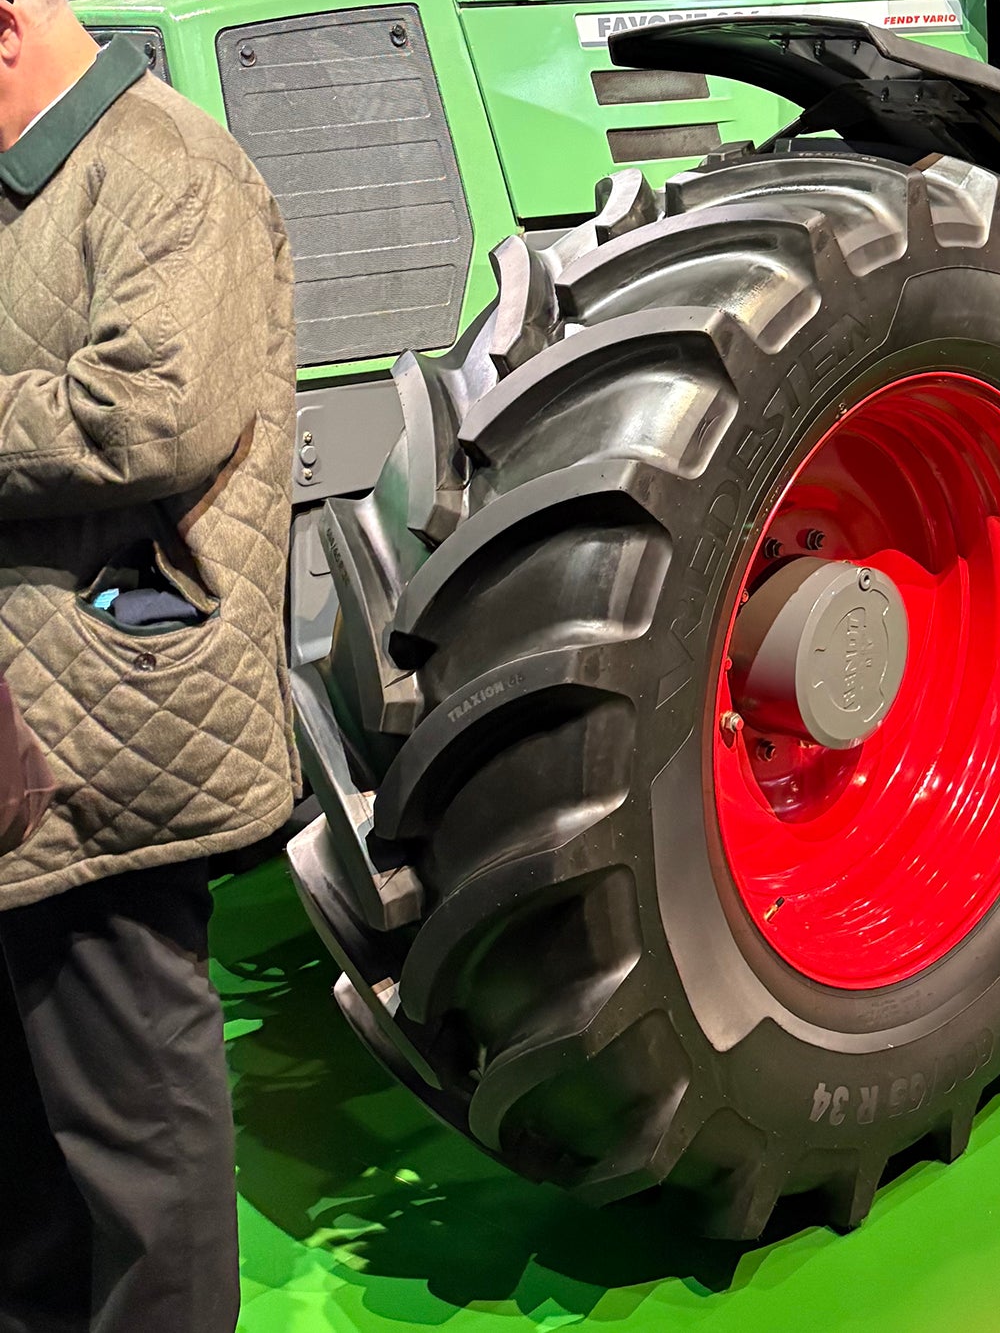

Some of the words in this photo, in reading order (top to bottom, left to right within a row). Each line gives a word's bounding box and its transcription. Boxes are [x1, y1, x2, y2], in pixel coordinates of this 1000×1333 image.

[884, 16, 920, 25] FENDT
[923, 14, 956, 23] VARIO
[447, 681, 505, 723] TRAXION
[809, 1082, 849, 1126] 34
[857, 1085, 879, 1124] R
